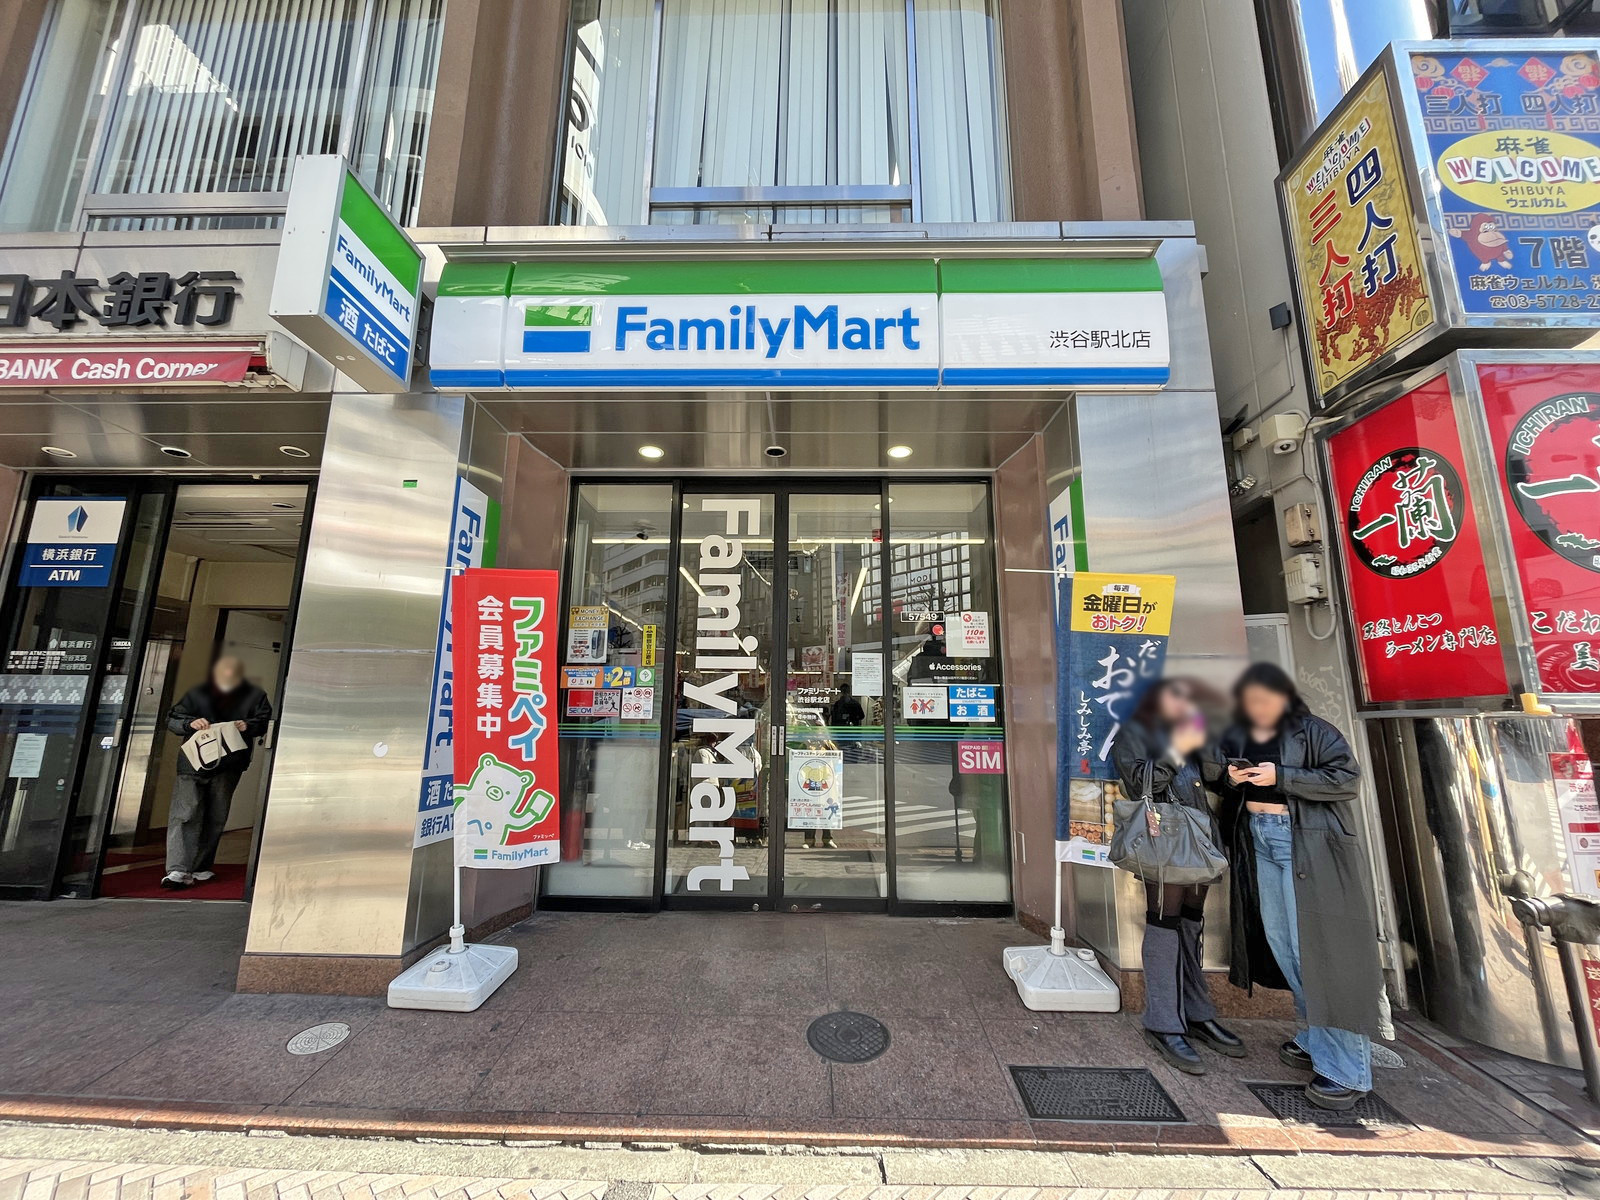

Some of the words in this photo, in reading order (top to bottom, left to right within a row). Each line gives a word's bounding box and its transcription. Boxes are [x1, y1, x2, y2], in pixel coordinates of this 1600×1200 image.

[1424, 93, 1502, 115] 三人打
[1520, 93, 1600, 115] 四人打
[1306, 121, 1368, 193] WELCOME
[1495, 136, 1553, 155] 麻雀
[1317, 146, 1360, 195] SHIBUYA
[1447, 157, 1600, 181] WELCOME
[1500, 186, 1566, 195] SHIBUYA
[1506, 197, 1568, 208] ウェルカム
[1345, 147, 1398, 299] 四人打
[1308, 189, 1354, 330] 三人打
[1518, 236, 1589, 269] 7階
[336, 233, 412, 323] FamilyMart
[1469, 274, 1588, 291] 麻雀ウェルカム
[1506, 294, 1600, 309] 03-5728-2
[338, 296, 358, 337] 酒
[362, 322, 397, 367] たばこ
[615, 304, 921, 360] FamilyMart
[1049, 329, 1151, 350] 渋谷駅北店
[0, 358, 63, 381] BANK
[70, 357, 131, 380] Cash
[135, 356, 219, 380] Corner
[1512, 396, 1590, 456] ICHIRAN
[1351, 456, 1393, 512] ICHIRAN
[1353, 456, 1457, 549] 一蘭
[42, 548, 97, 562] 横浜銀行
[48, 569, 81, 581] ATM
[1083, 594, 1159, 614] 金曜日が
[1091, 614, 1147, 632] おトク!
[1362, 613, 1443, 641] 天然とんこつ
[1385, 625, 1498, 658] ラーメン専門店
[476, 595, 505, 739] 会員募集中
[508, 597, 547, 761] ファミペイ
[936, 663, 981, 671] Accessories
[683, 499, 761, 891] FamilyMart
[797, 687, 841, 695] ファミリーマート
[956, 687, 987, 698] たばこ
[957, 705, 967, 716] お
[977, 705, 988, 716] 酒
[1077, 690, 1093, 756] しみしみ亭
[961, 751, 1000, 769] SIM
[426, 779, 441, 806] 酒
[491, 847, 549, 861] FamilyMart
